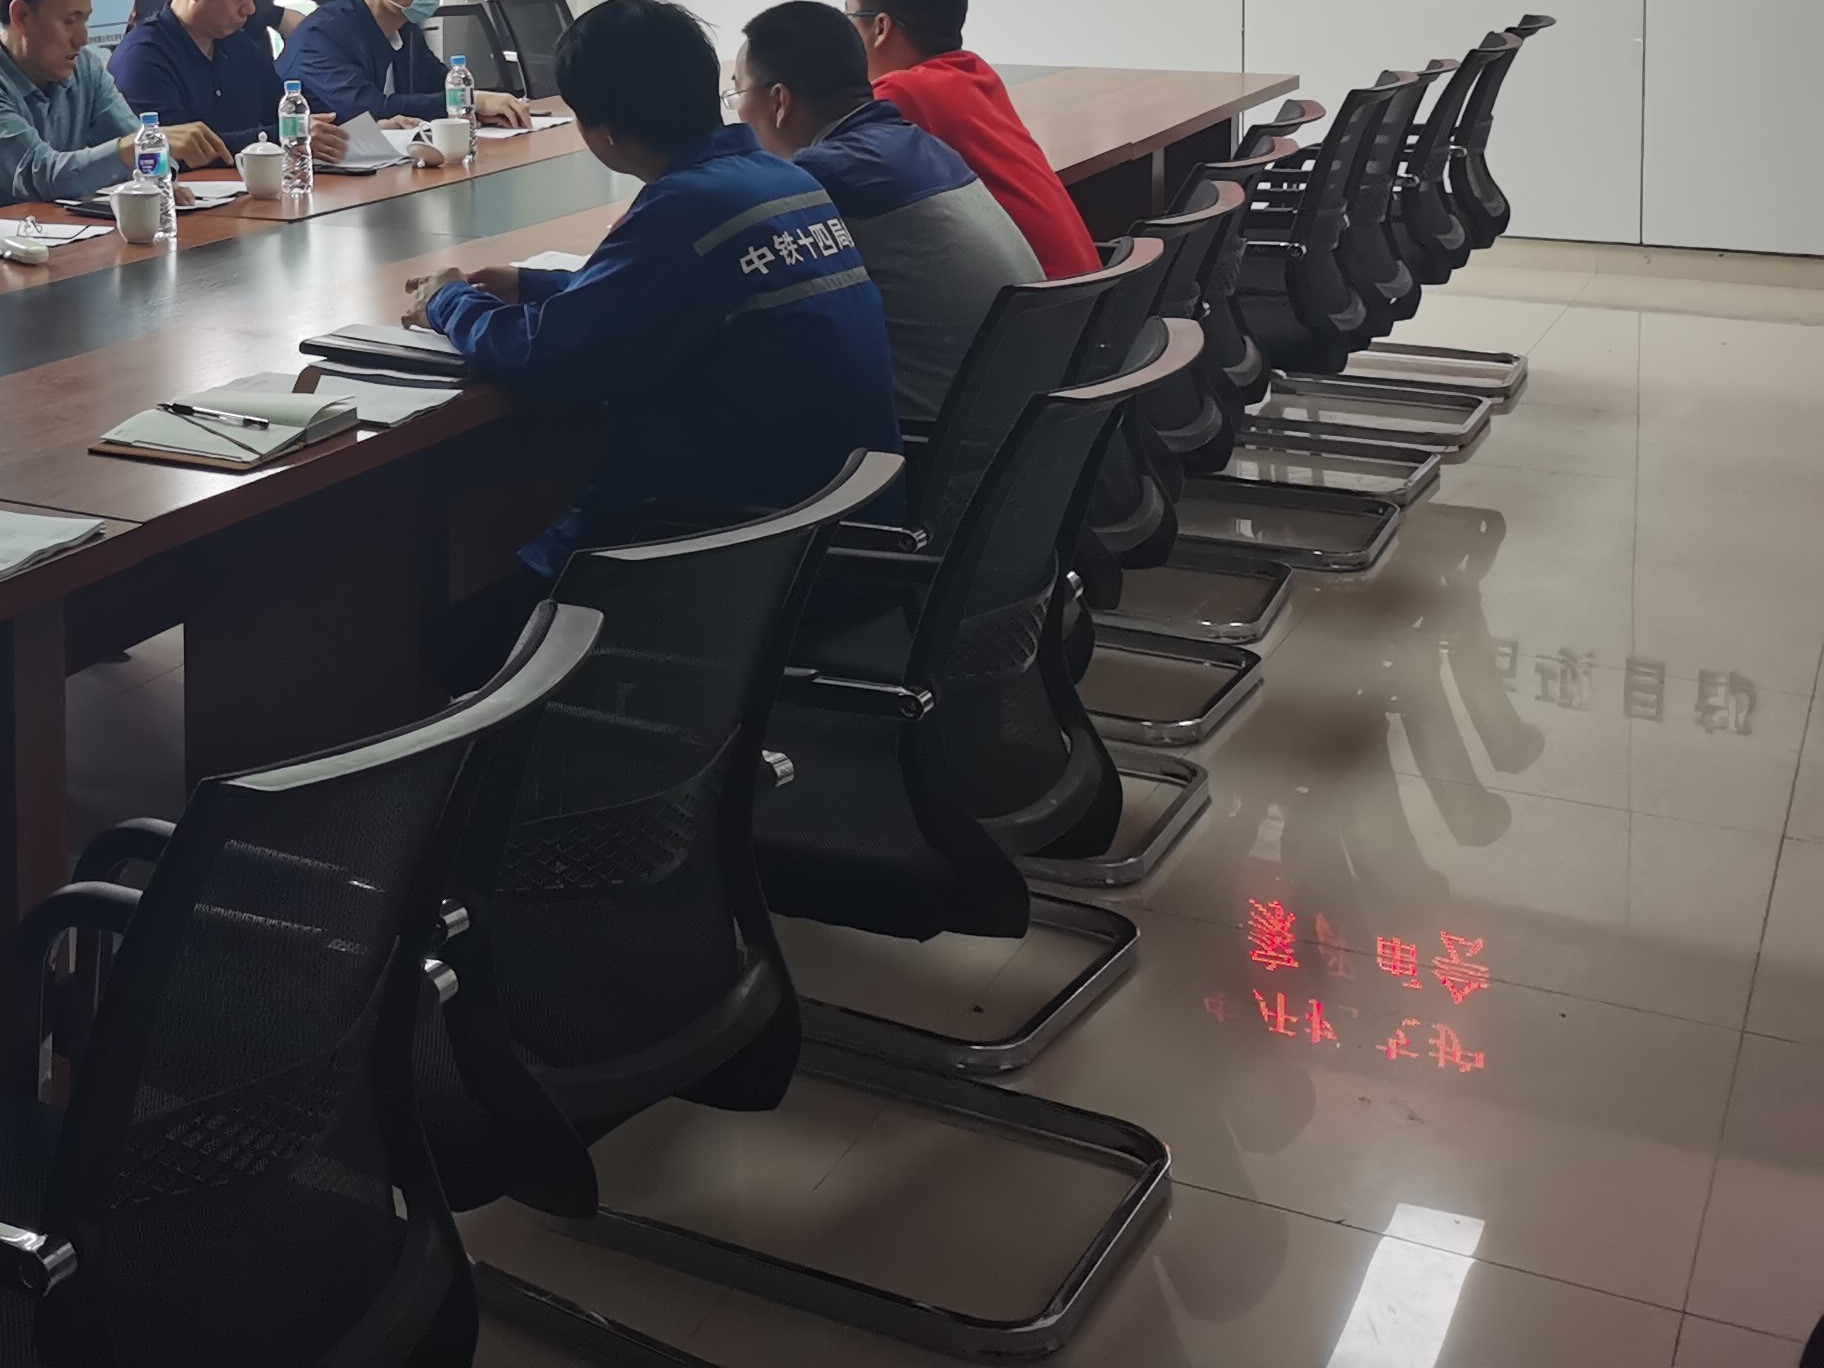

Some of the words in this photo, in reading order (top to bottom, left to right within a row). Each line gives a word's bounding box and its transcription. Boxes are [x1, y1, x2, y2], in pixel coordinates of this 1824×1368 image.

[740, 218, 856, 275] 中铁十四局
